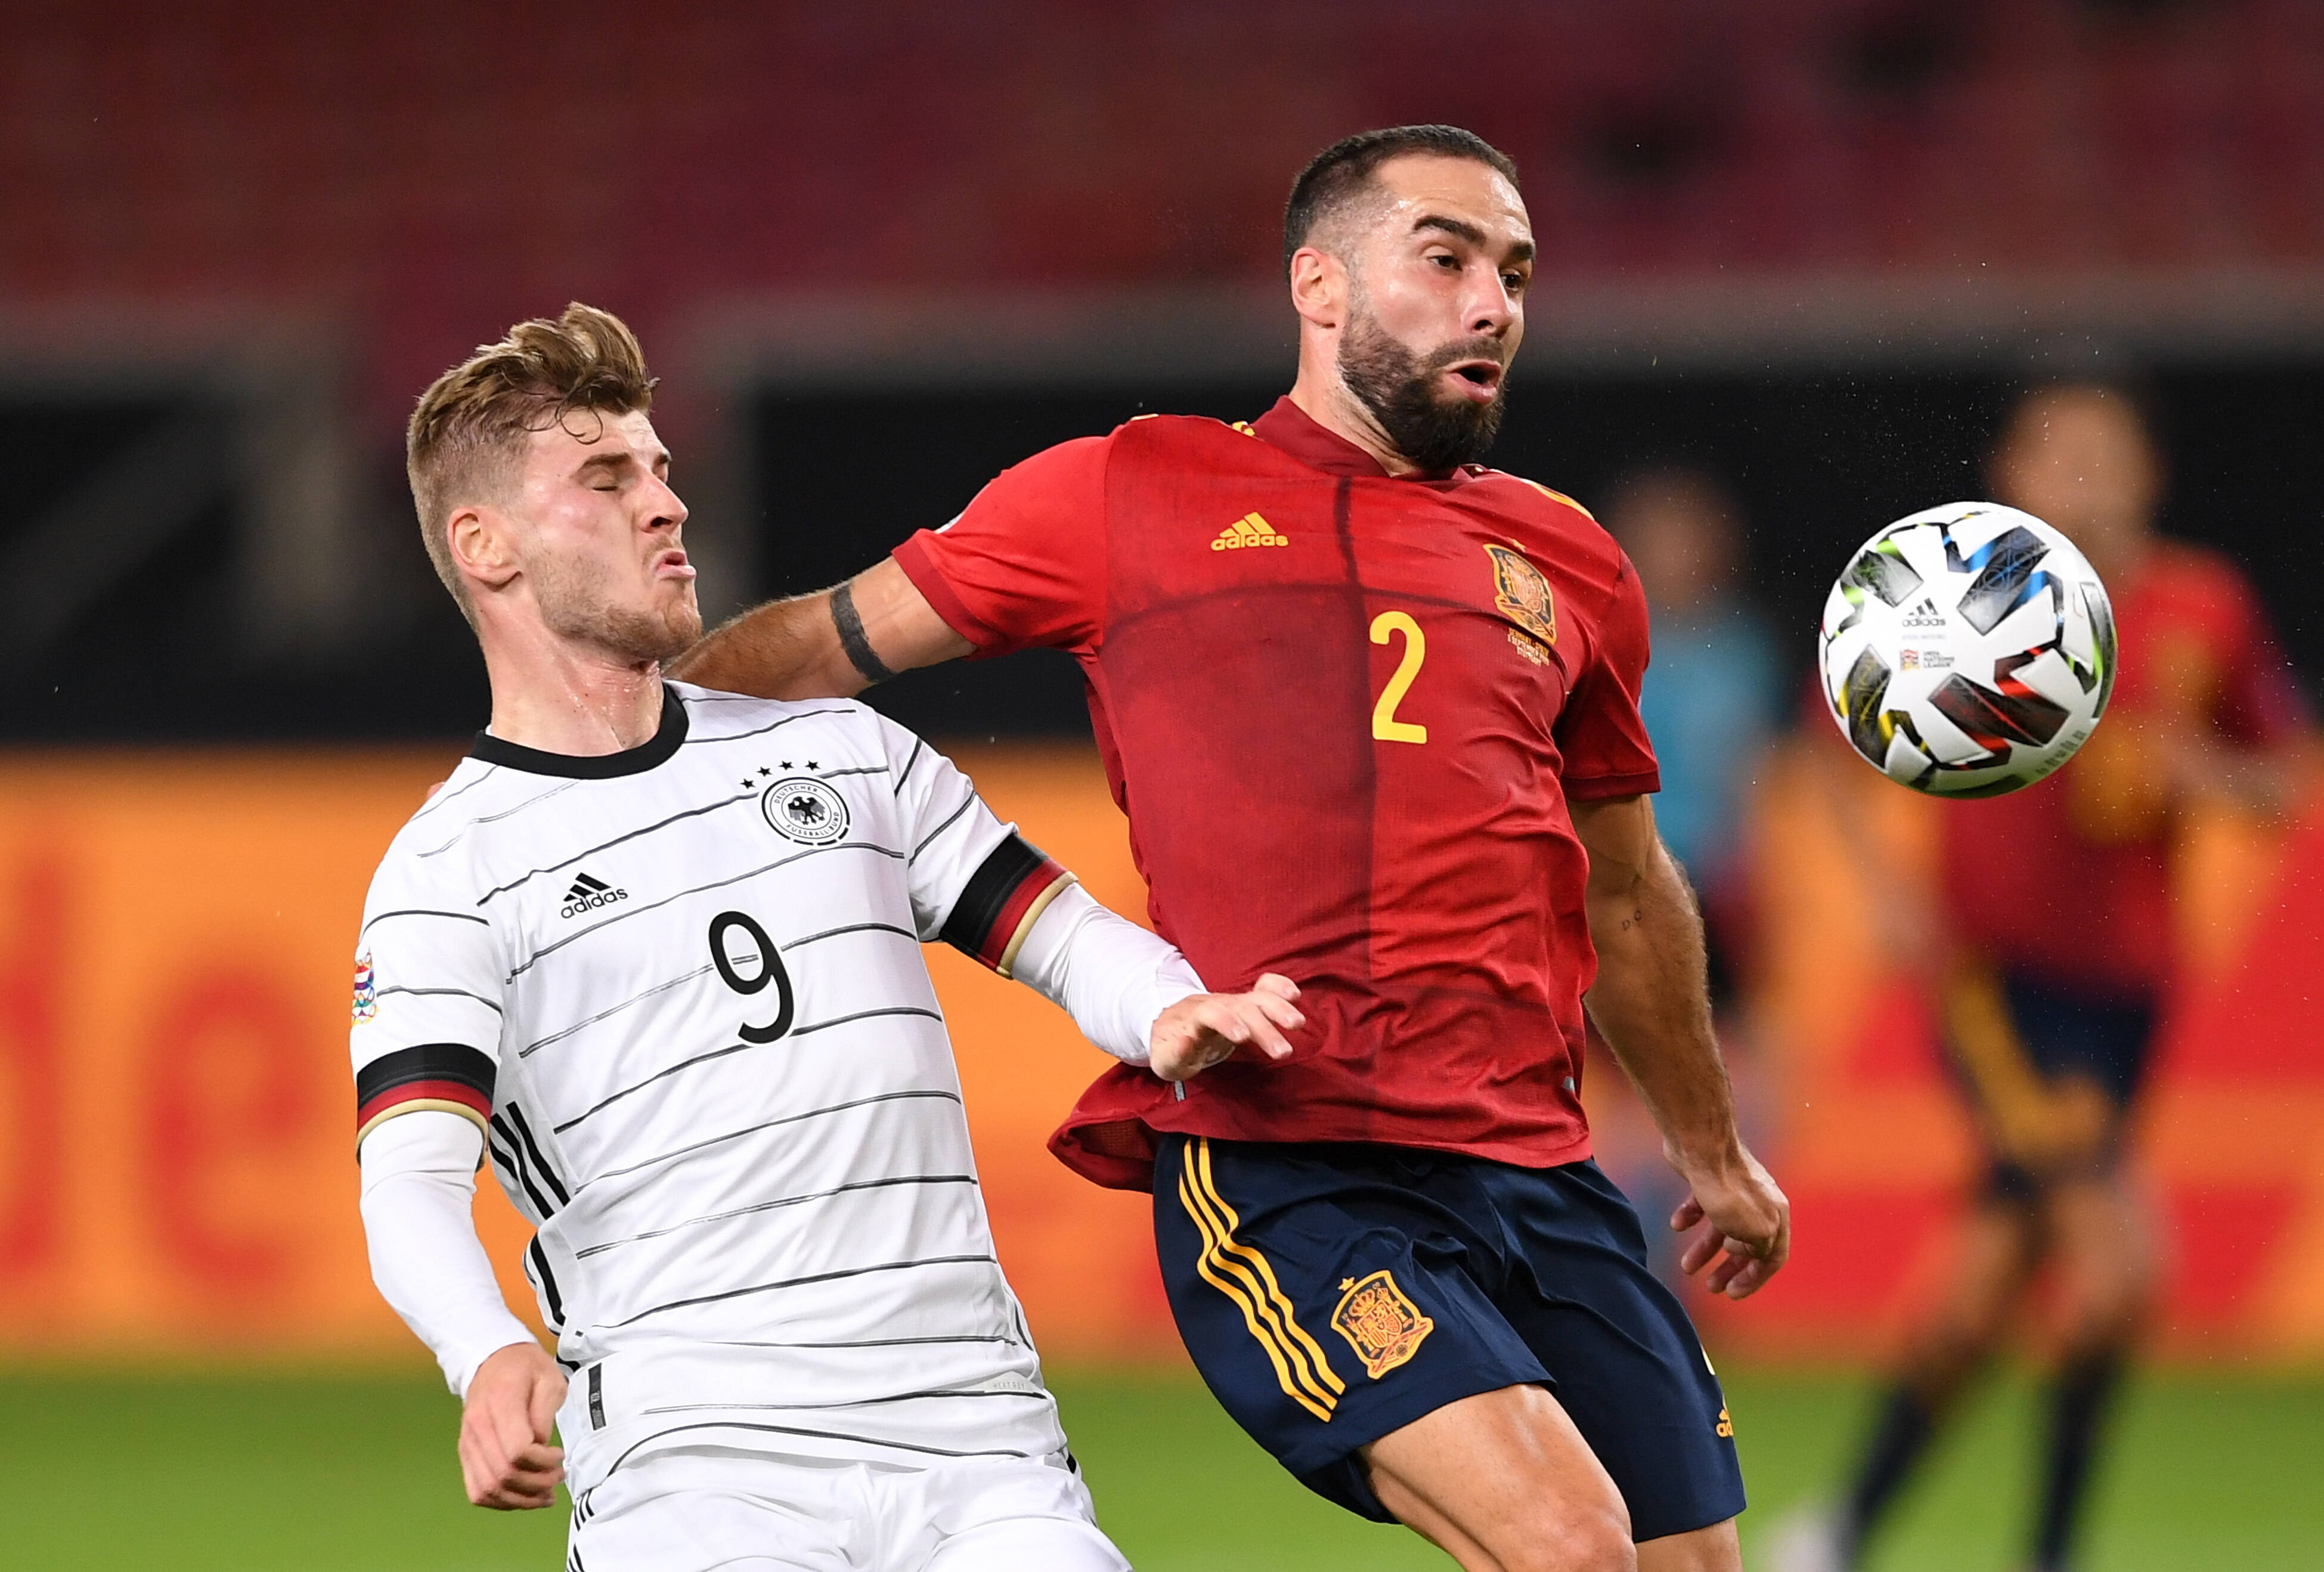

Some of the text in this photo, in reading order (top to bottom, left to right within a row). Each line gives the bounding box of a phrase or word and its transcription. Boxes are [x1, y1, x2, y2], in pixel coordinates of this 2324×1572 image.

[1210, 533, 1289, 551] adidas
[1902, 618, 1946, 627] adidas
[1369, 611, 1427, 744] 2
[774, 785, 818, 804] DEUTSCHER
[560, 888, 628, 919] adidas
[709, 911, 794, 1043] 9
